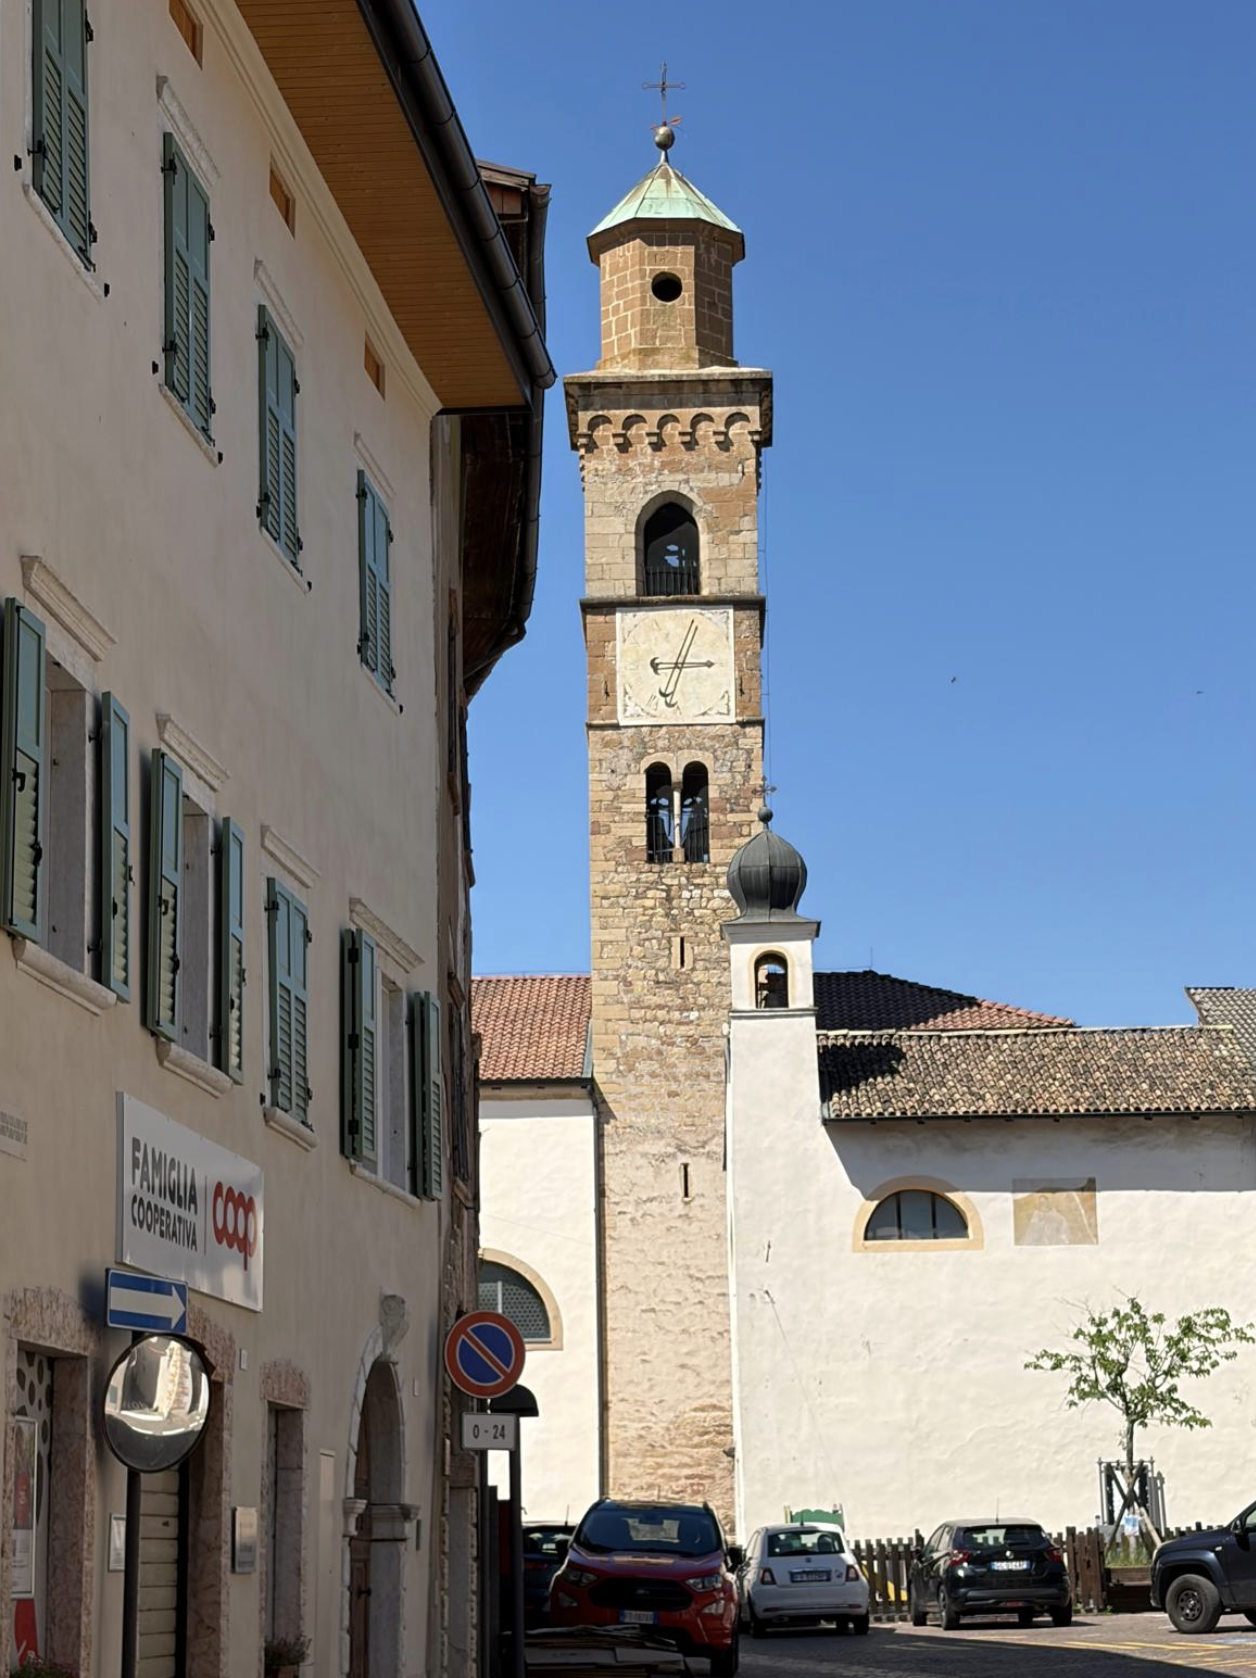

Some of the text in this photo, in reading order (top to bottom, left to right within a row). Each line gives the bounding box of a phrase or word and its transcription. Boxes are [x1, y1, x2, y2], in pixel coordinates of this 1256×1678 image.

[132, 1137, 198, 1215] FAMIGLIA
[131, 1194, 198, 1252] COOPERATIVA
[473, 1424, 480, 1439] 0
[492, 1424, 505, 1439] 24
